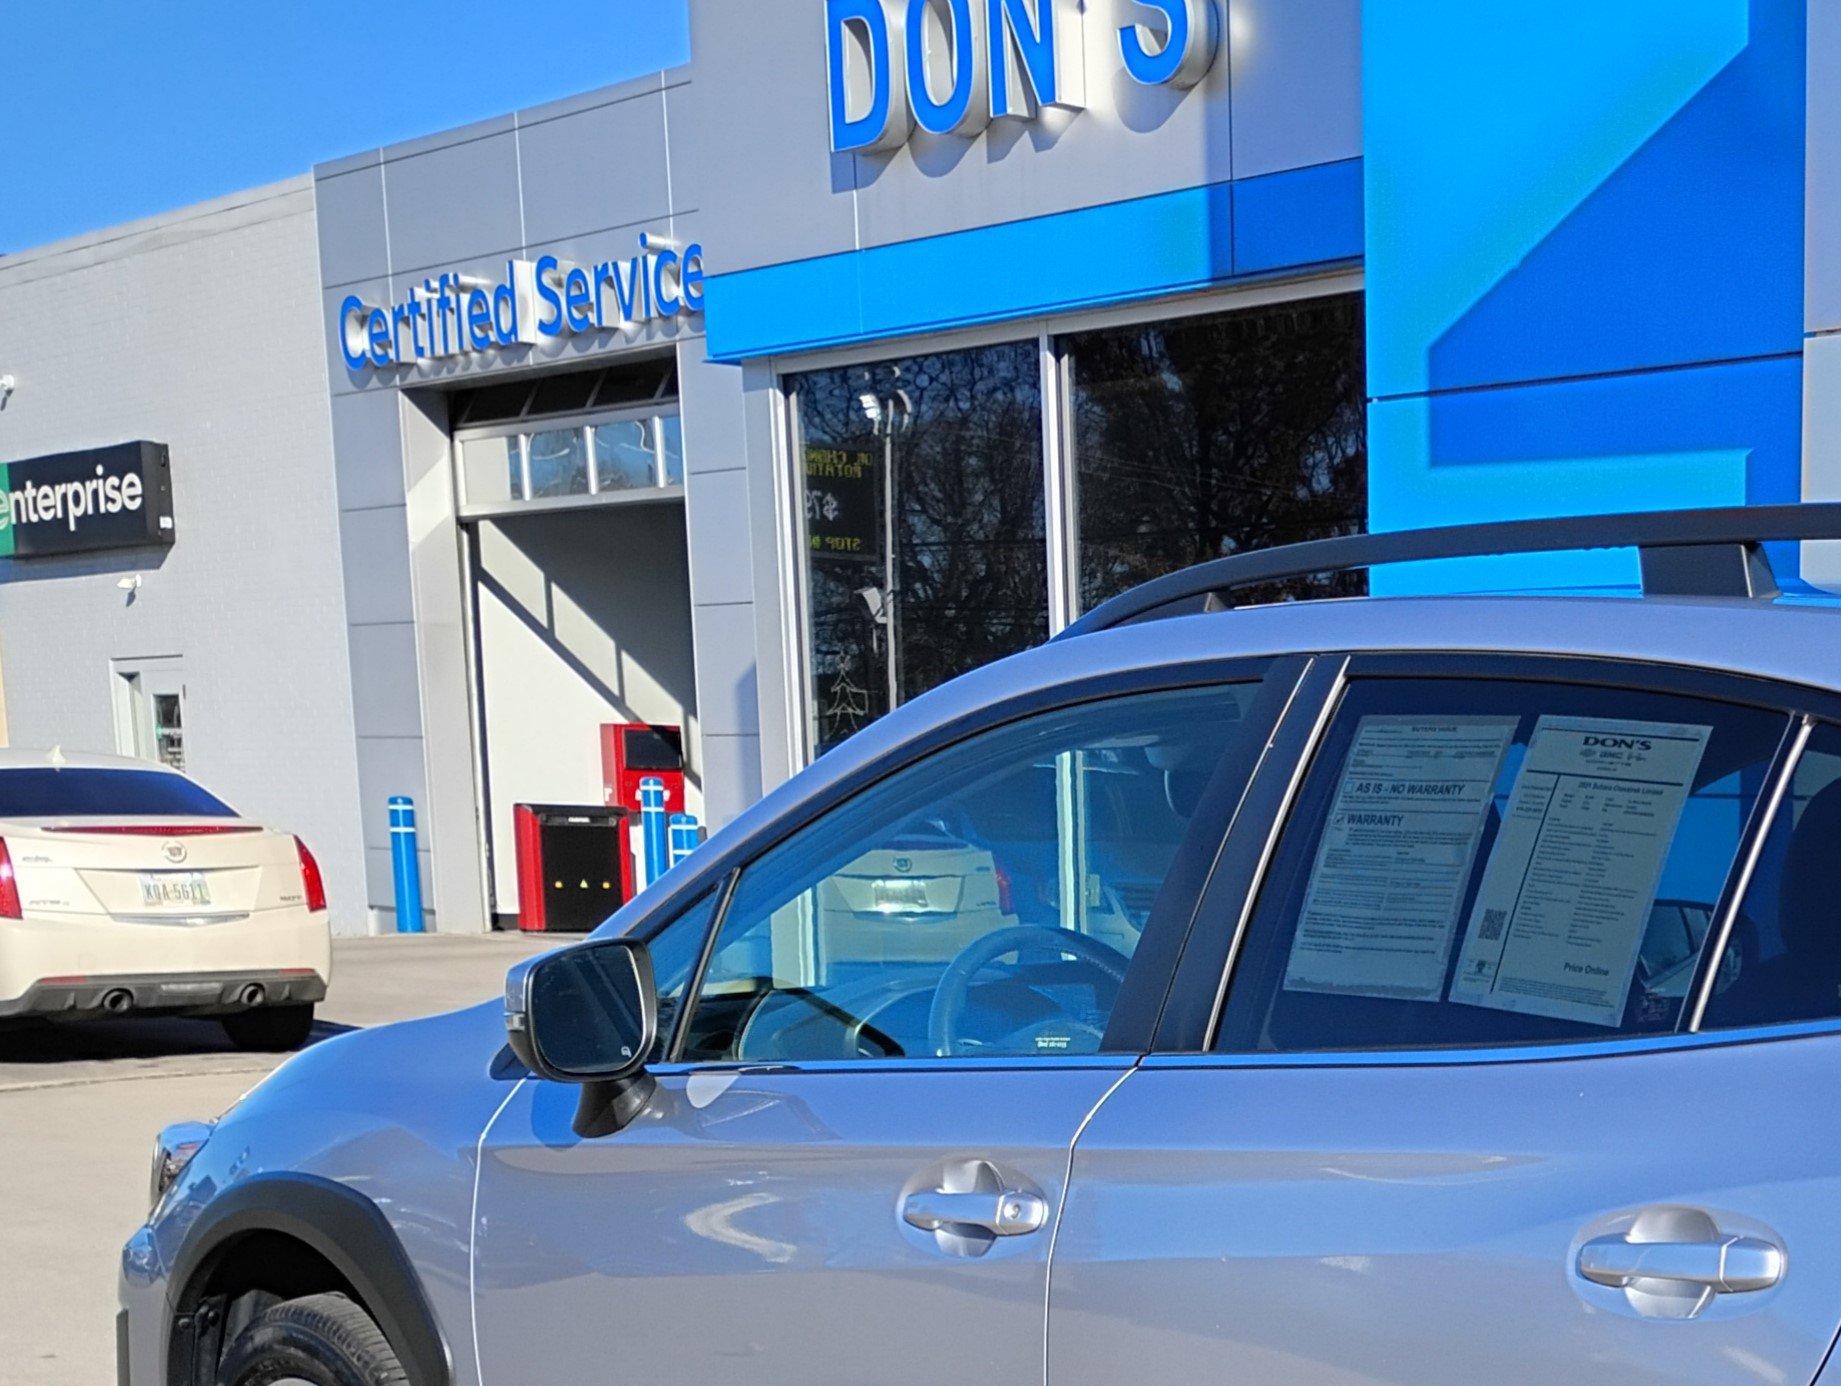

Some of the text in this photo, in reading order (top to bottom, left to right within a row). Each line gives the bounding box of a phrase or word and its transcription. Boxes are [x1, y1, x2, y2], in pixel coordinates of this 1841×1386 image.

[824, 0, 1190, 152] DONS
[339, 232, 704, 371] Certified Service
[1583, 736, 1651, 750] DON'S
[1356, 783, 1372, 794] AS
[1373, 783, 1383, 794] IS
[1391, 783, 1405, 795] NO
[1407, 783, 1465, 796] WARRANTY
[1347, 814, 1403, 826] WARRANTY
[1563, 962, 1609, 977] Price Online
